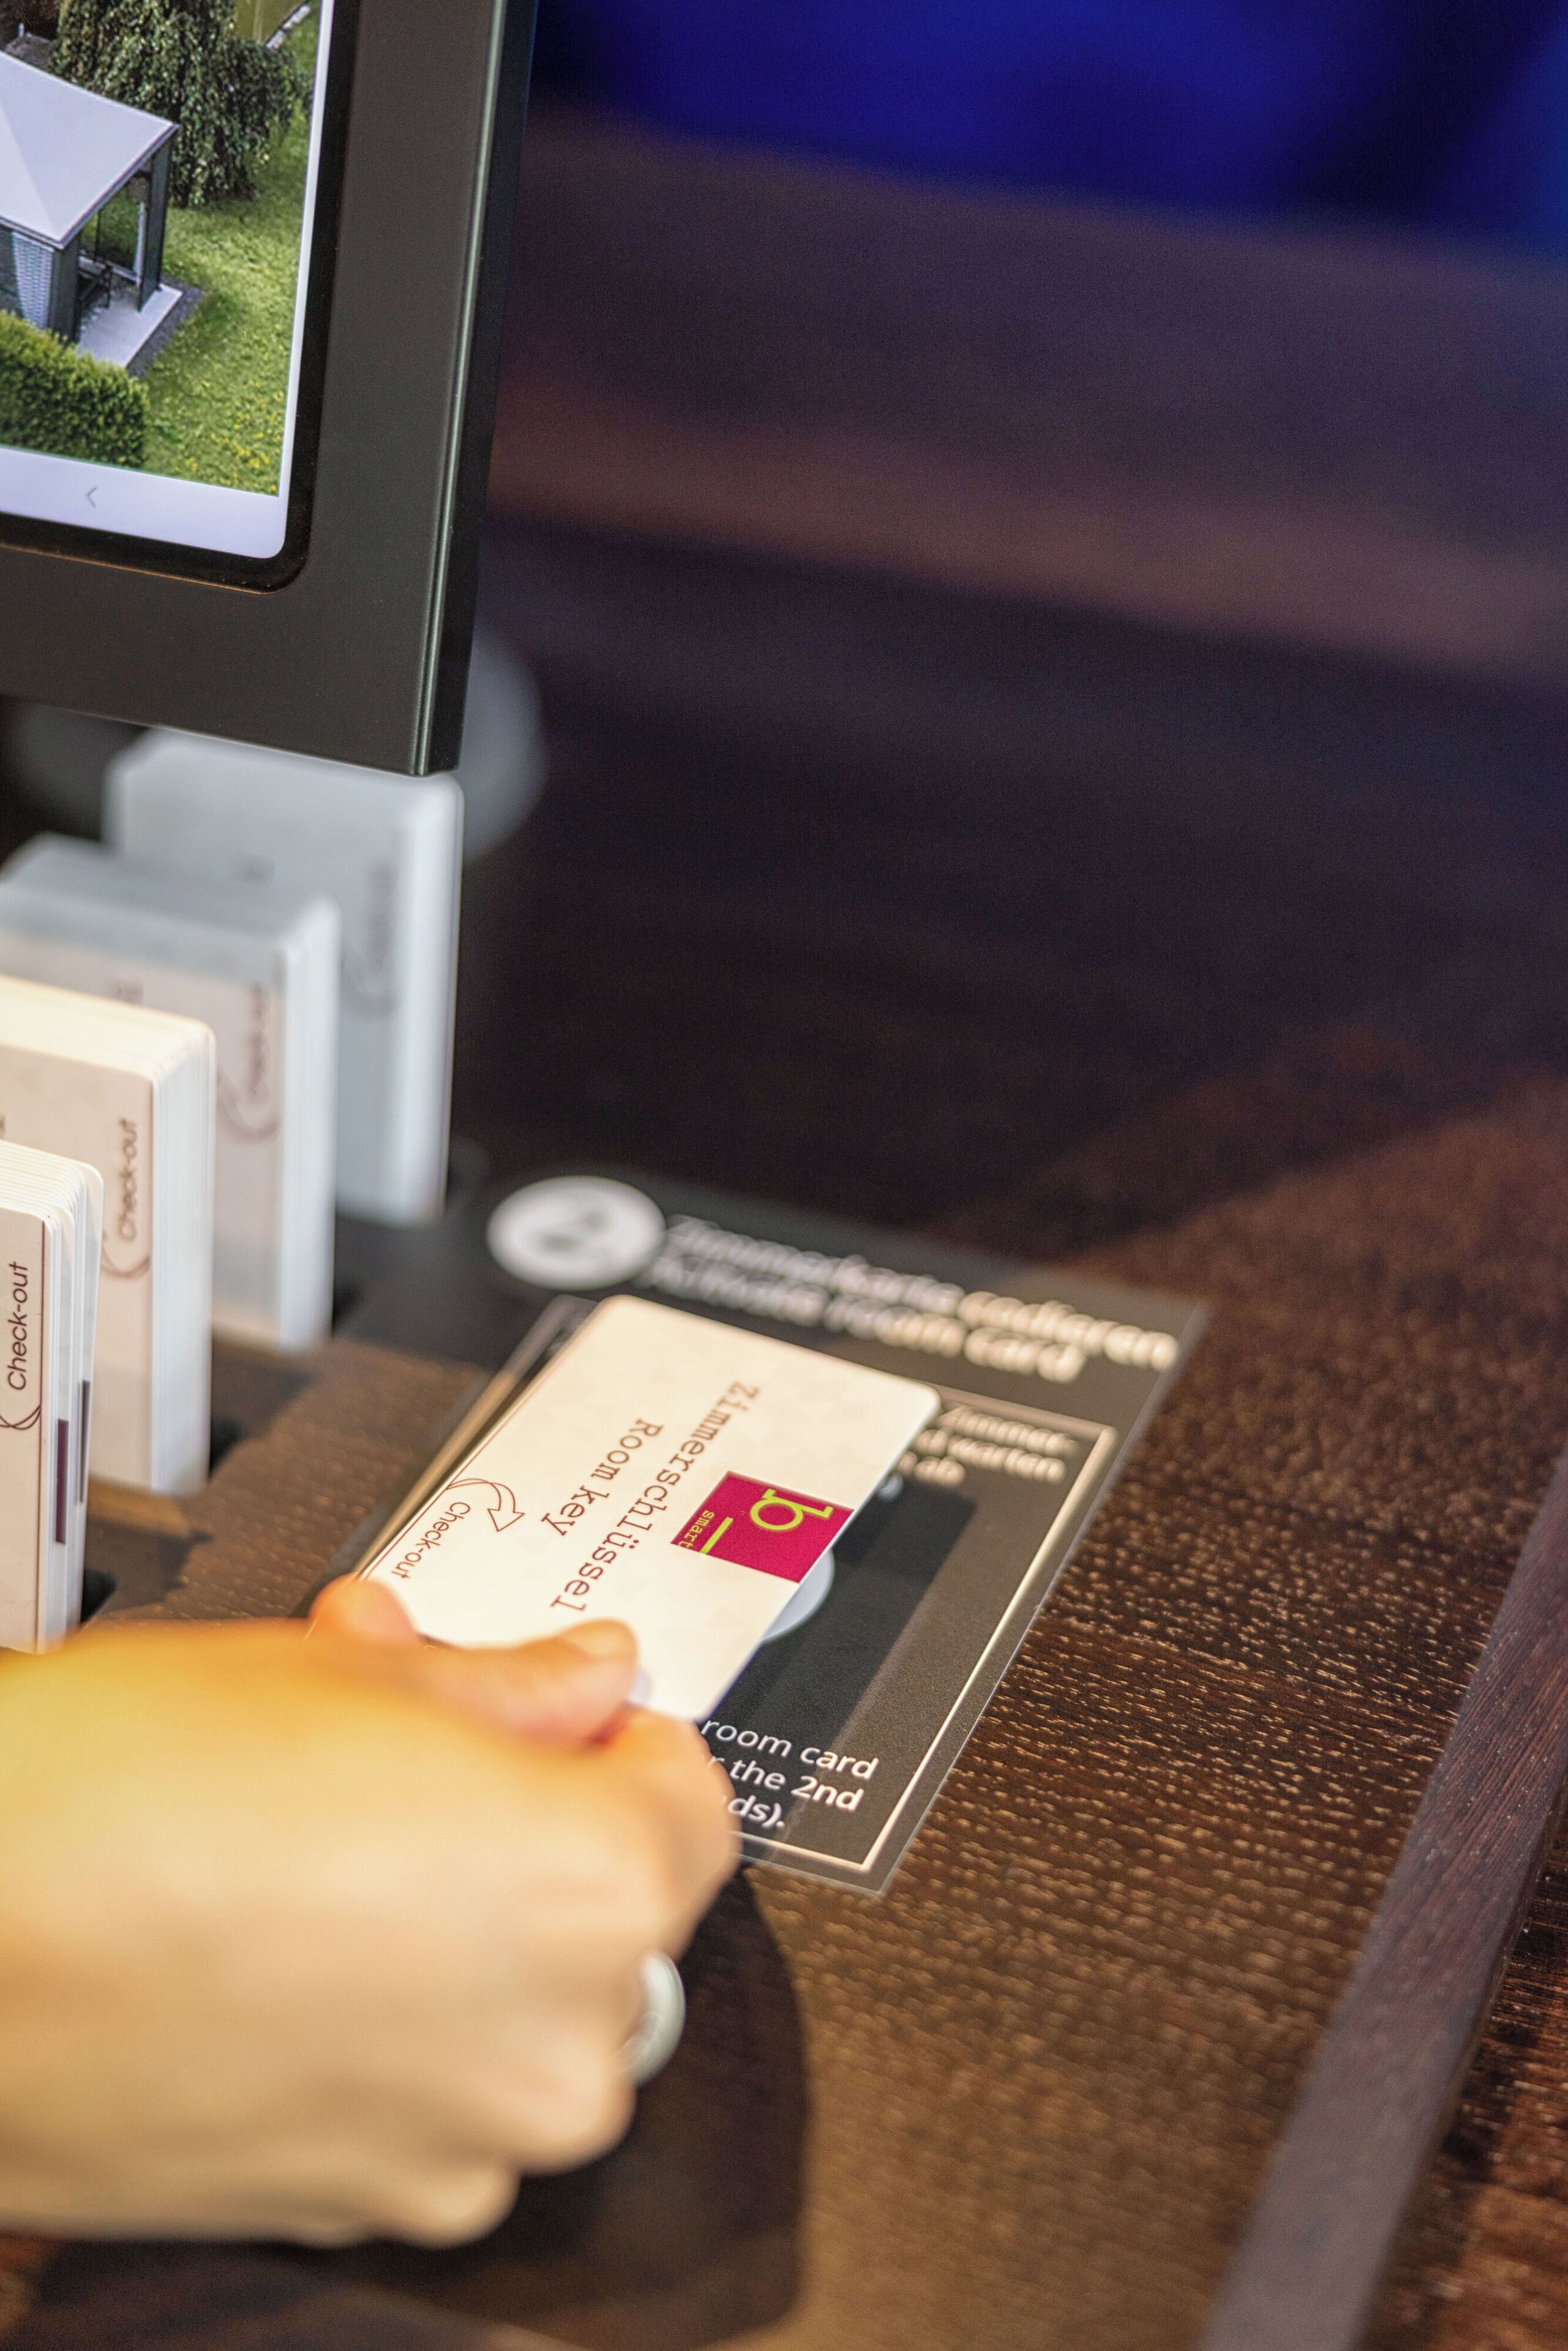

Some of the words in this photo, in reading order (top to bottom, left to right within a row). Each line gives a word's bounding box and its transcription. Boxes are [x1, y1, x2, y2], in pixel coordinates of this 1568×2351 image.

[118, 1116, 138, 1243] Check-out
[7, 1261, 28, 1392] Check-out
[591, 1417, 665, 1482] Room
[540, 1485, 610, 1537] key
[550, 1380, 760, 1611] Zimmerschlüssel
[392, 1501, 471, 1580] Check-out
[677, 1509, 715, 1550] smart
[700, 1719, 792, 1758] room
[800, 1746, 879, 1780] card
[729, 1759, 786, 1790] the
[790, 1775, 865, 1812] 2nd
